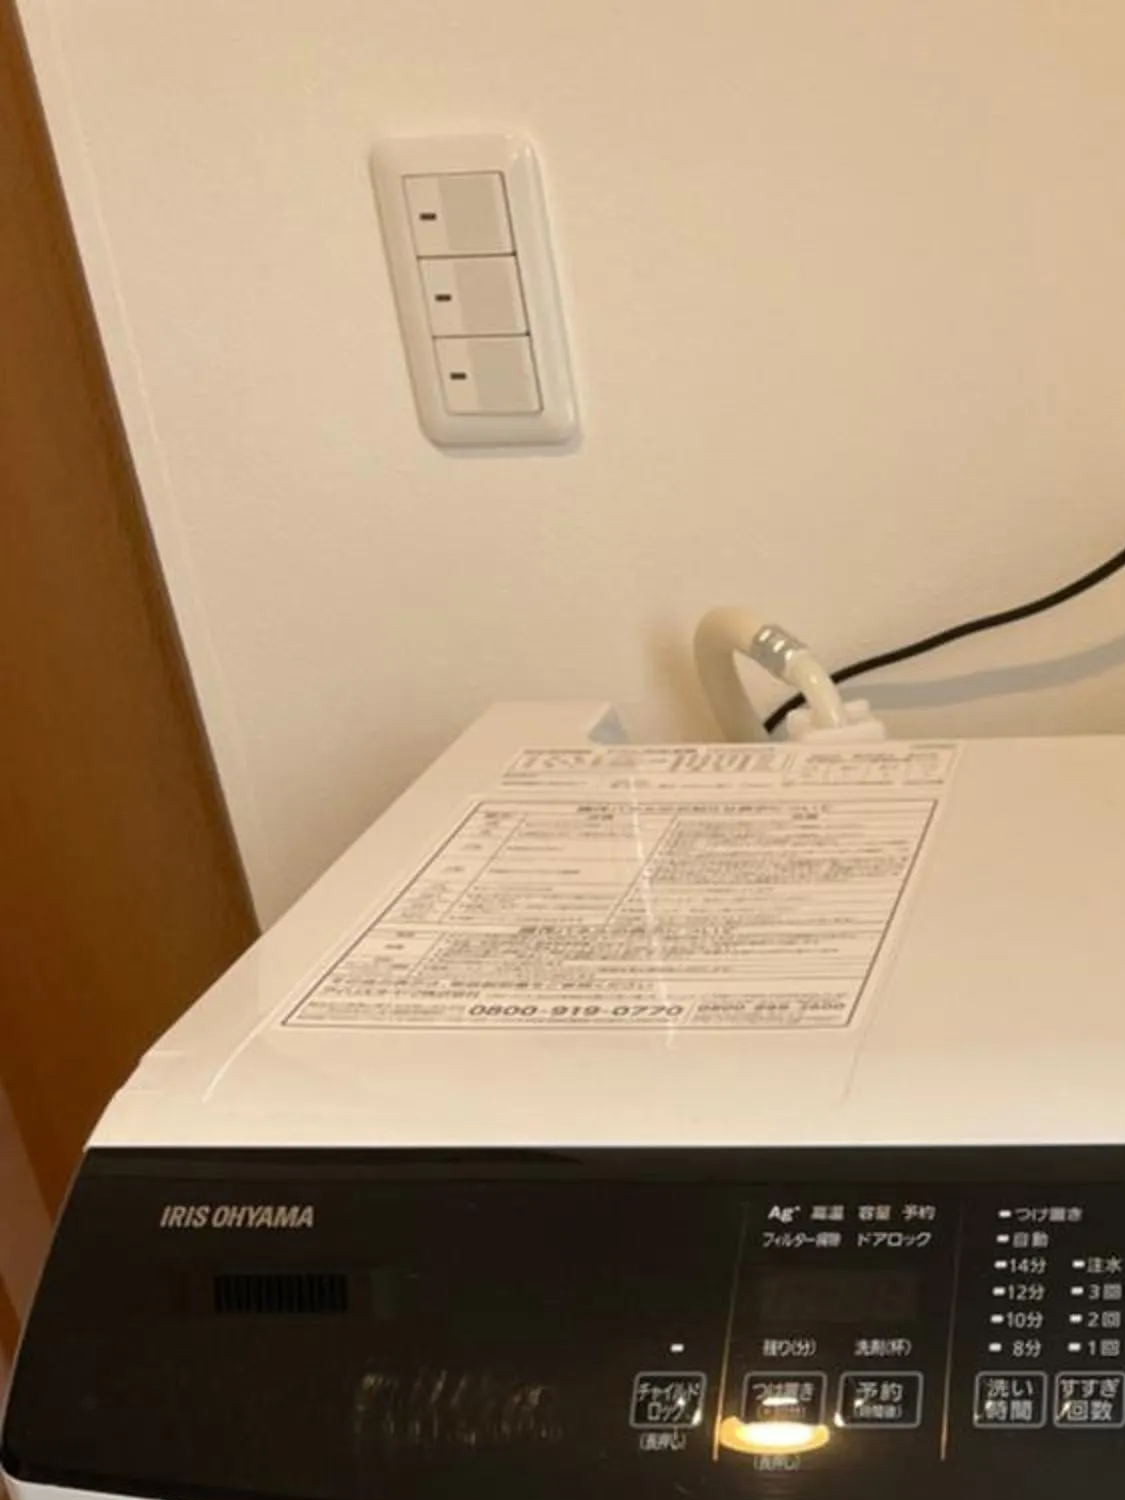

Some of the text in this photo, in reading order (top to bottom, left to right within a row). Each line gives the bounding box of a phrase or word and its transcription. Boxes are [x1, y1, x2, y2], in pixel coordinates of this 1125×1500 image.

[160, 1206, 315, 1228] IRIS OHYAMA
[857, 1231, 932, 1247] ドアロック
[1010, 1257, 1047, 1275] 14分
[1007, 1284, 1046, 1301] 12分
[1088, 1283, 1123, 1301] 3回
[1006, 1311, 1044, 1329] 10分
[1087, 1311, 1122, 1328] 2回
[1012, 1340, 1042, 1357] 8分
[1088, 1339, 1121, 1357] 1回
[855, 1381, 904, 1402] 予約
[987, 1377, 1034, 1399] 洗い
[1060, 1378, 1121, 1398] すすぎ
[985, 1400, 1033, 1421] 時間
[1067, 1401, 1113, 1421] 回数
